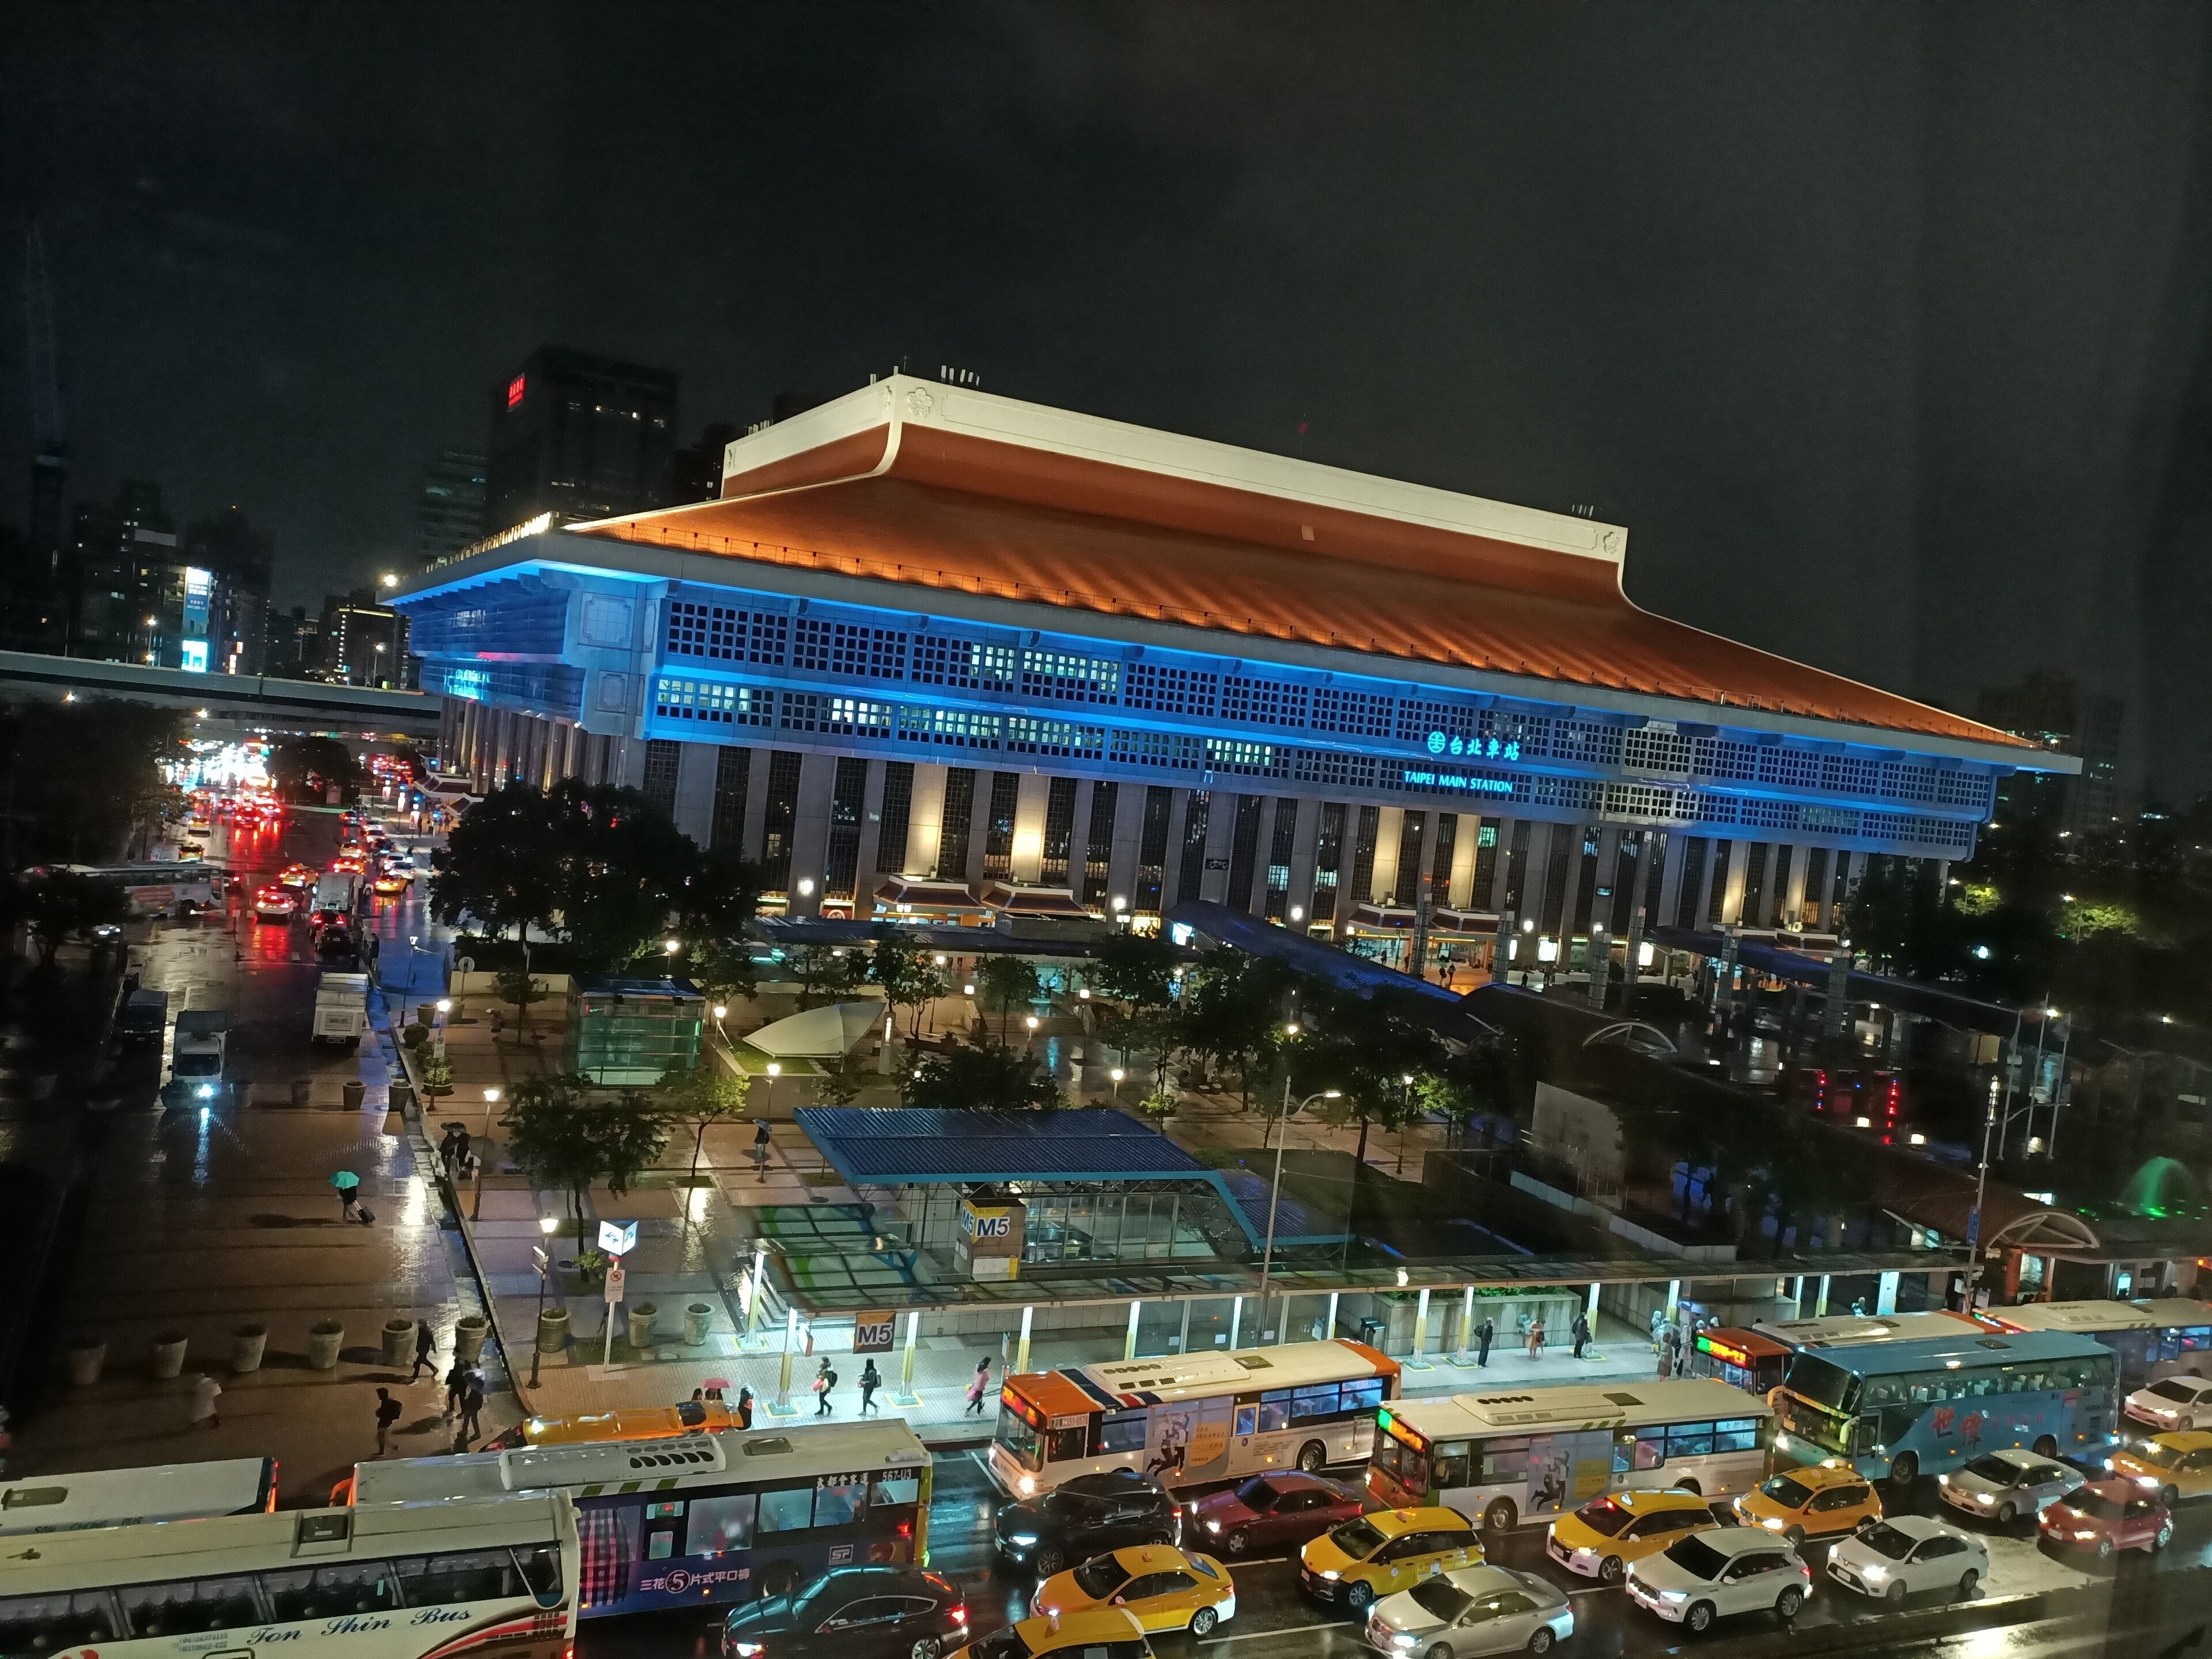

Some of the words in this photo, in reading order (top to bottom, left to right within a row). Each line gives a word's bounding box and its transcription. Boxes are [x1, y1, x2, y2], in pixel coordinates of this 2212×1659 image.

[1450, 735, 1520, 761] 台北車站
[1404, 771, 1435, 785] TAIPEI
[1438, 774, 1467, 788] MAIN
[1469, 778, 1513, 793] STATION
[961, 1208, 974, 1234] M5
[976, 1218, 1009, 1237] M5
[858, 1324, 891, 1343] M5
[882, 1468, 912, 1482] 567-U3
[247, 1626, 302, 1646] Ton
[320, 1616, 392, 1637] Shin
[410, 1607, 473, 1626] Bus
